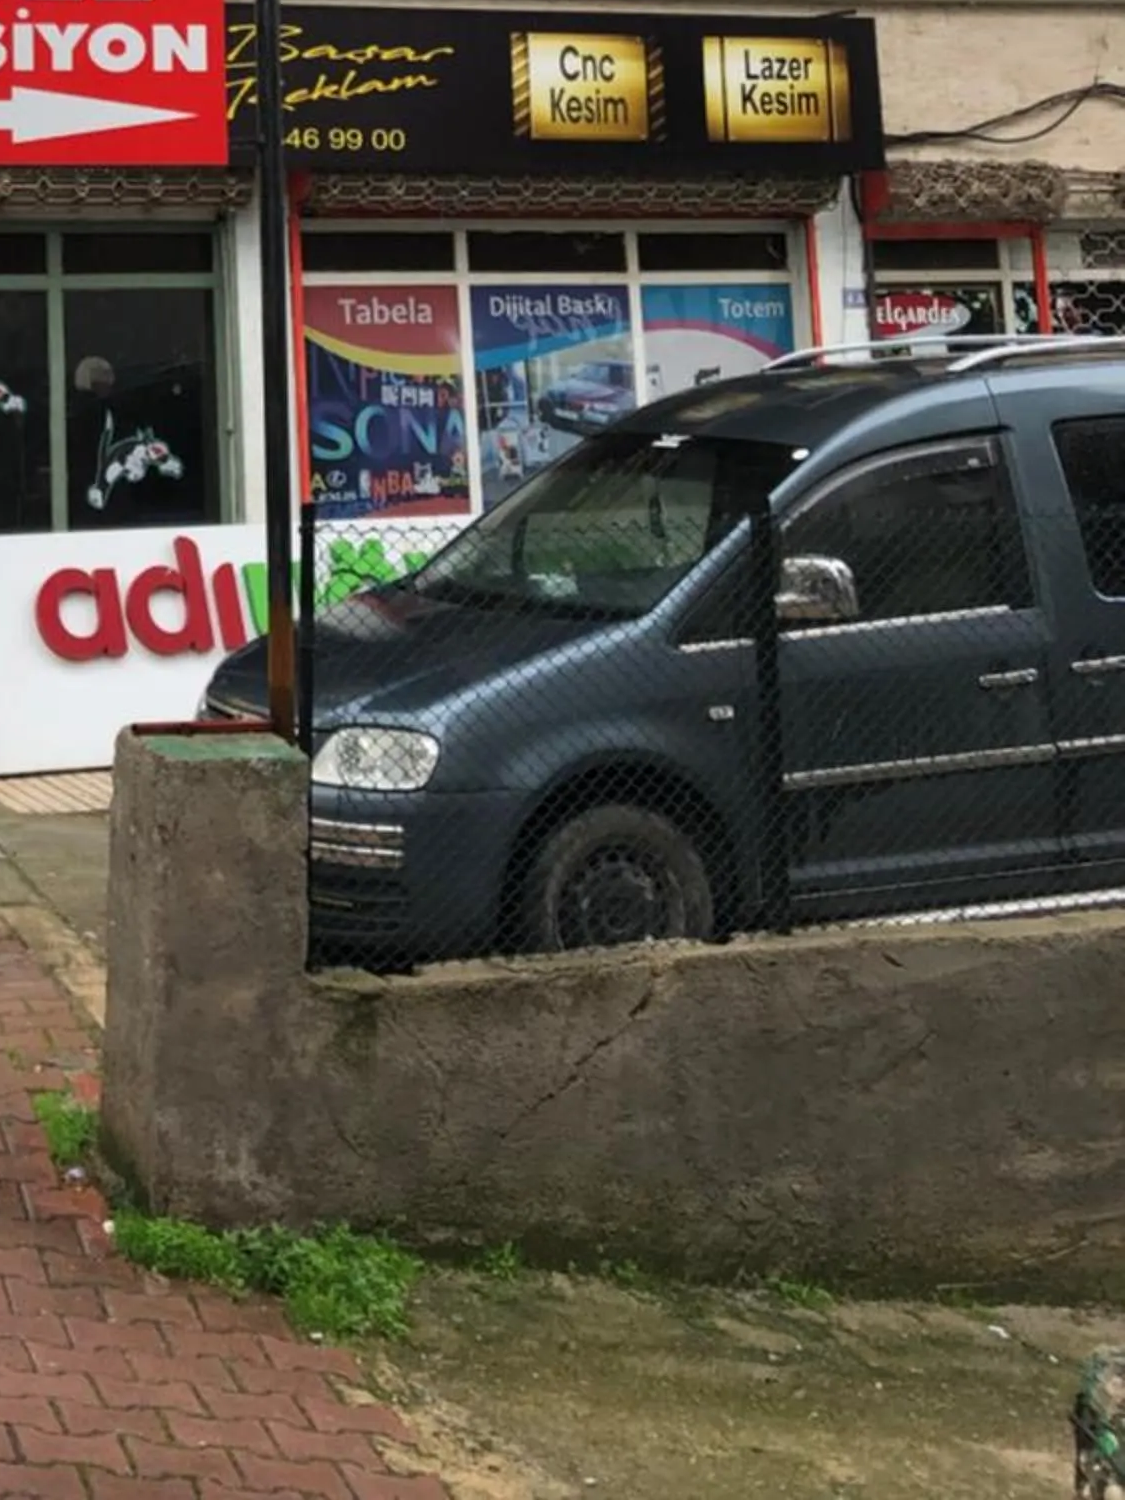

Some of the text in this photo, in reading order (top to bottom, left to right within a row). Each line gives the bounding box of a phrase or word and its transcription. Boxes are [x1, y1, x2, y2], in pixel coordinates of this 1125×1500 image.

[559, 45, 615, 82] Cnc
[744, 49, 813, 81] Lazer
[549, 88, 629, 125] Kesim
[740, 84, 819, 116] Kesim
[282, 128, 406, 150] 46 99 00
[337, 297, 434, 325] Tabela
[488, 294, 552, 322] Dijital
[718, 298, 785, 318] Totem
